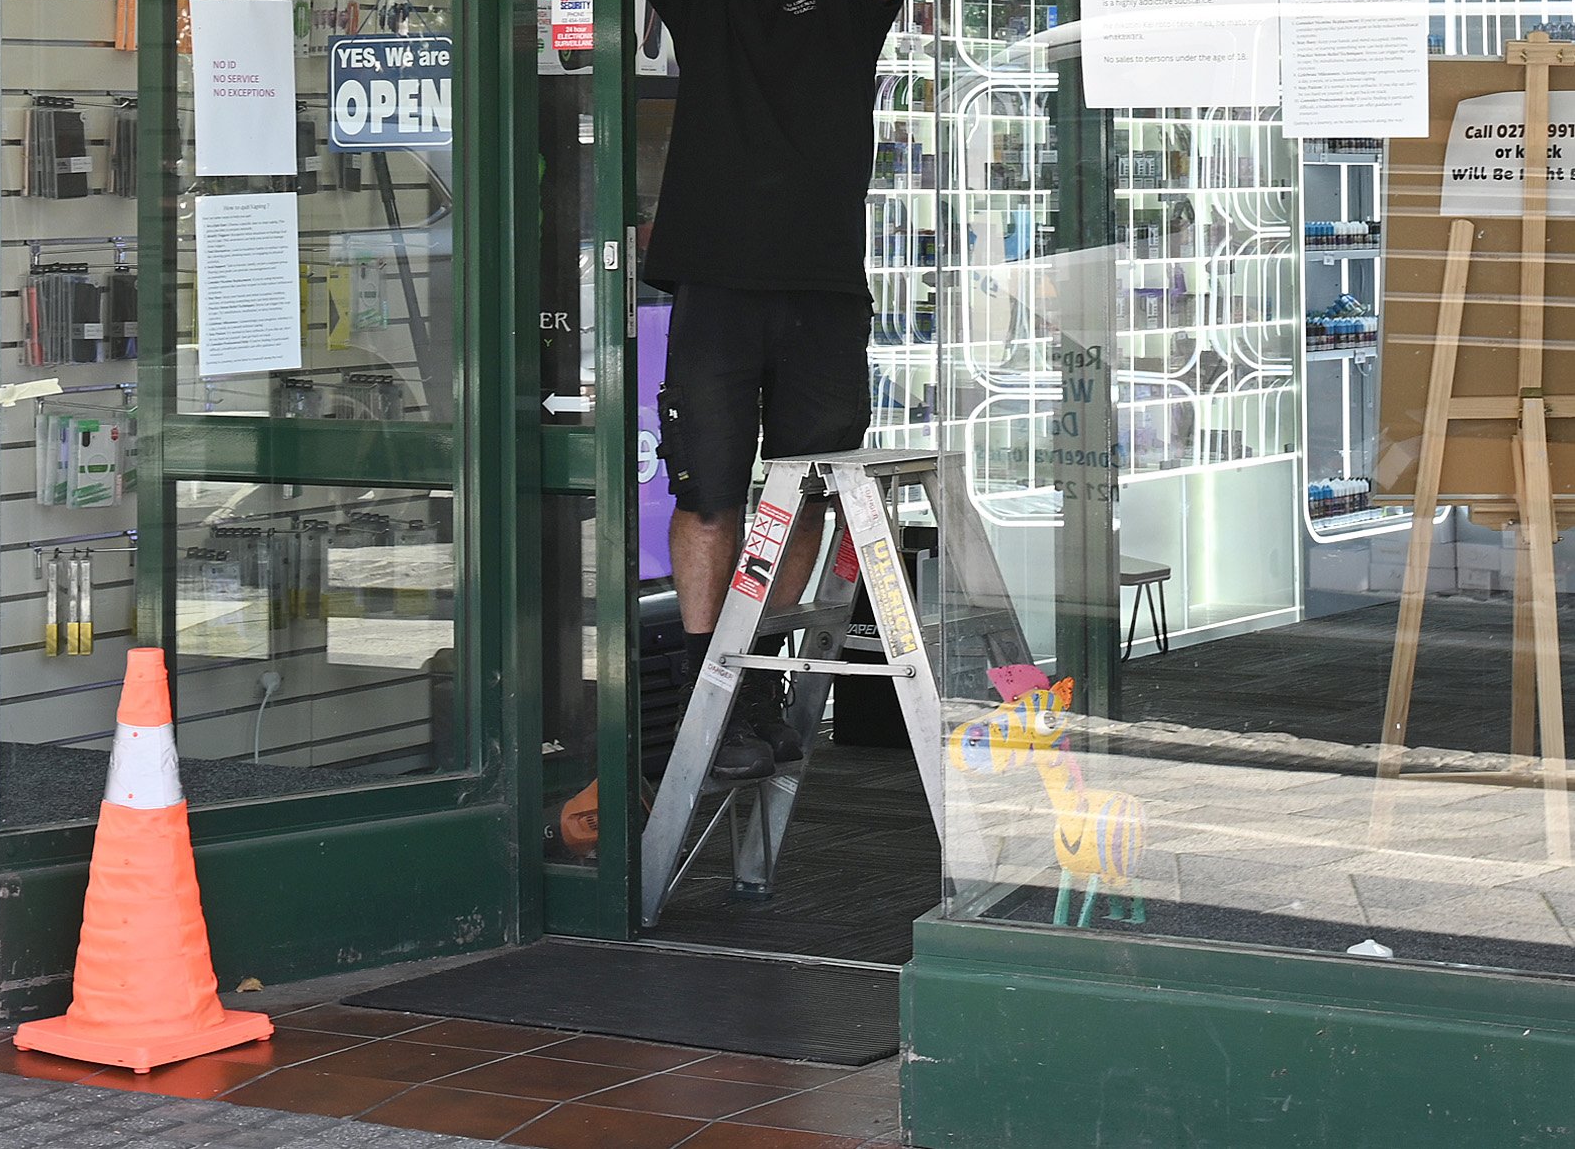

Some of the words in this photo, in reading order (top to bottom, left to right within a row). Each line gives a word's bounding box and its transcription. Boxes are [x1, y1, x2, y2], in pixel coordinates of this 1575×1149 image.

[560, 1, 591, 10] SECURITY
[213, 60, 225, 69] NO
[227, 60, 236, 69] ID
[337, 47, 382, 73] YES,
[385, 46, 415, 68] We
[419, 50, 451, 67] are
[1104, 55, 1114, 63] No
[1115, 55, 1134, 63] sales
[1144, 55, 1174, 65] persons
[1175, 54, 1197, 63] under
[1198, 53, 1210, 62] the
[1211, 54, 1226, 64] age
[213, 74, 225, 83] NO
[227, 74, 260, 83] SERVICE
[213, 88, 225, 97] NO
[228, 88, 275, 98] EXCEPTIONS
[335, 79, 452, 136] OPEN
[1465, 124, 1493, 139] Call
[1495, 146, 1510, 159] or
[1452, 166, 1487, 181] Will
[1493, 167, 1514, 181] Be
[539, 312, 571, 332] ER
[544, 338, 553, 348] Y
